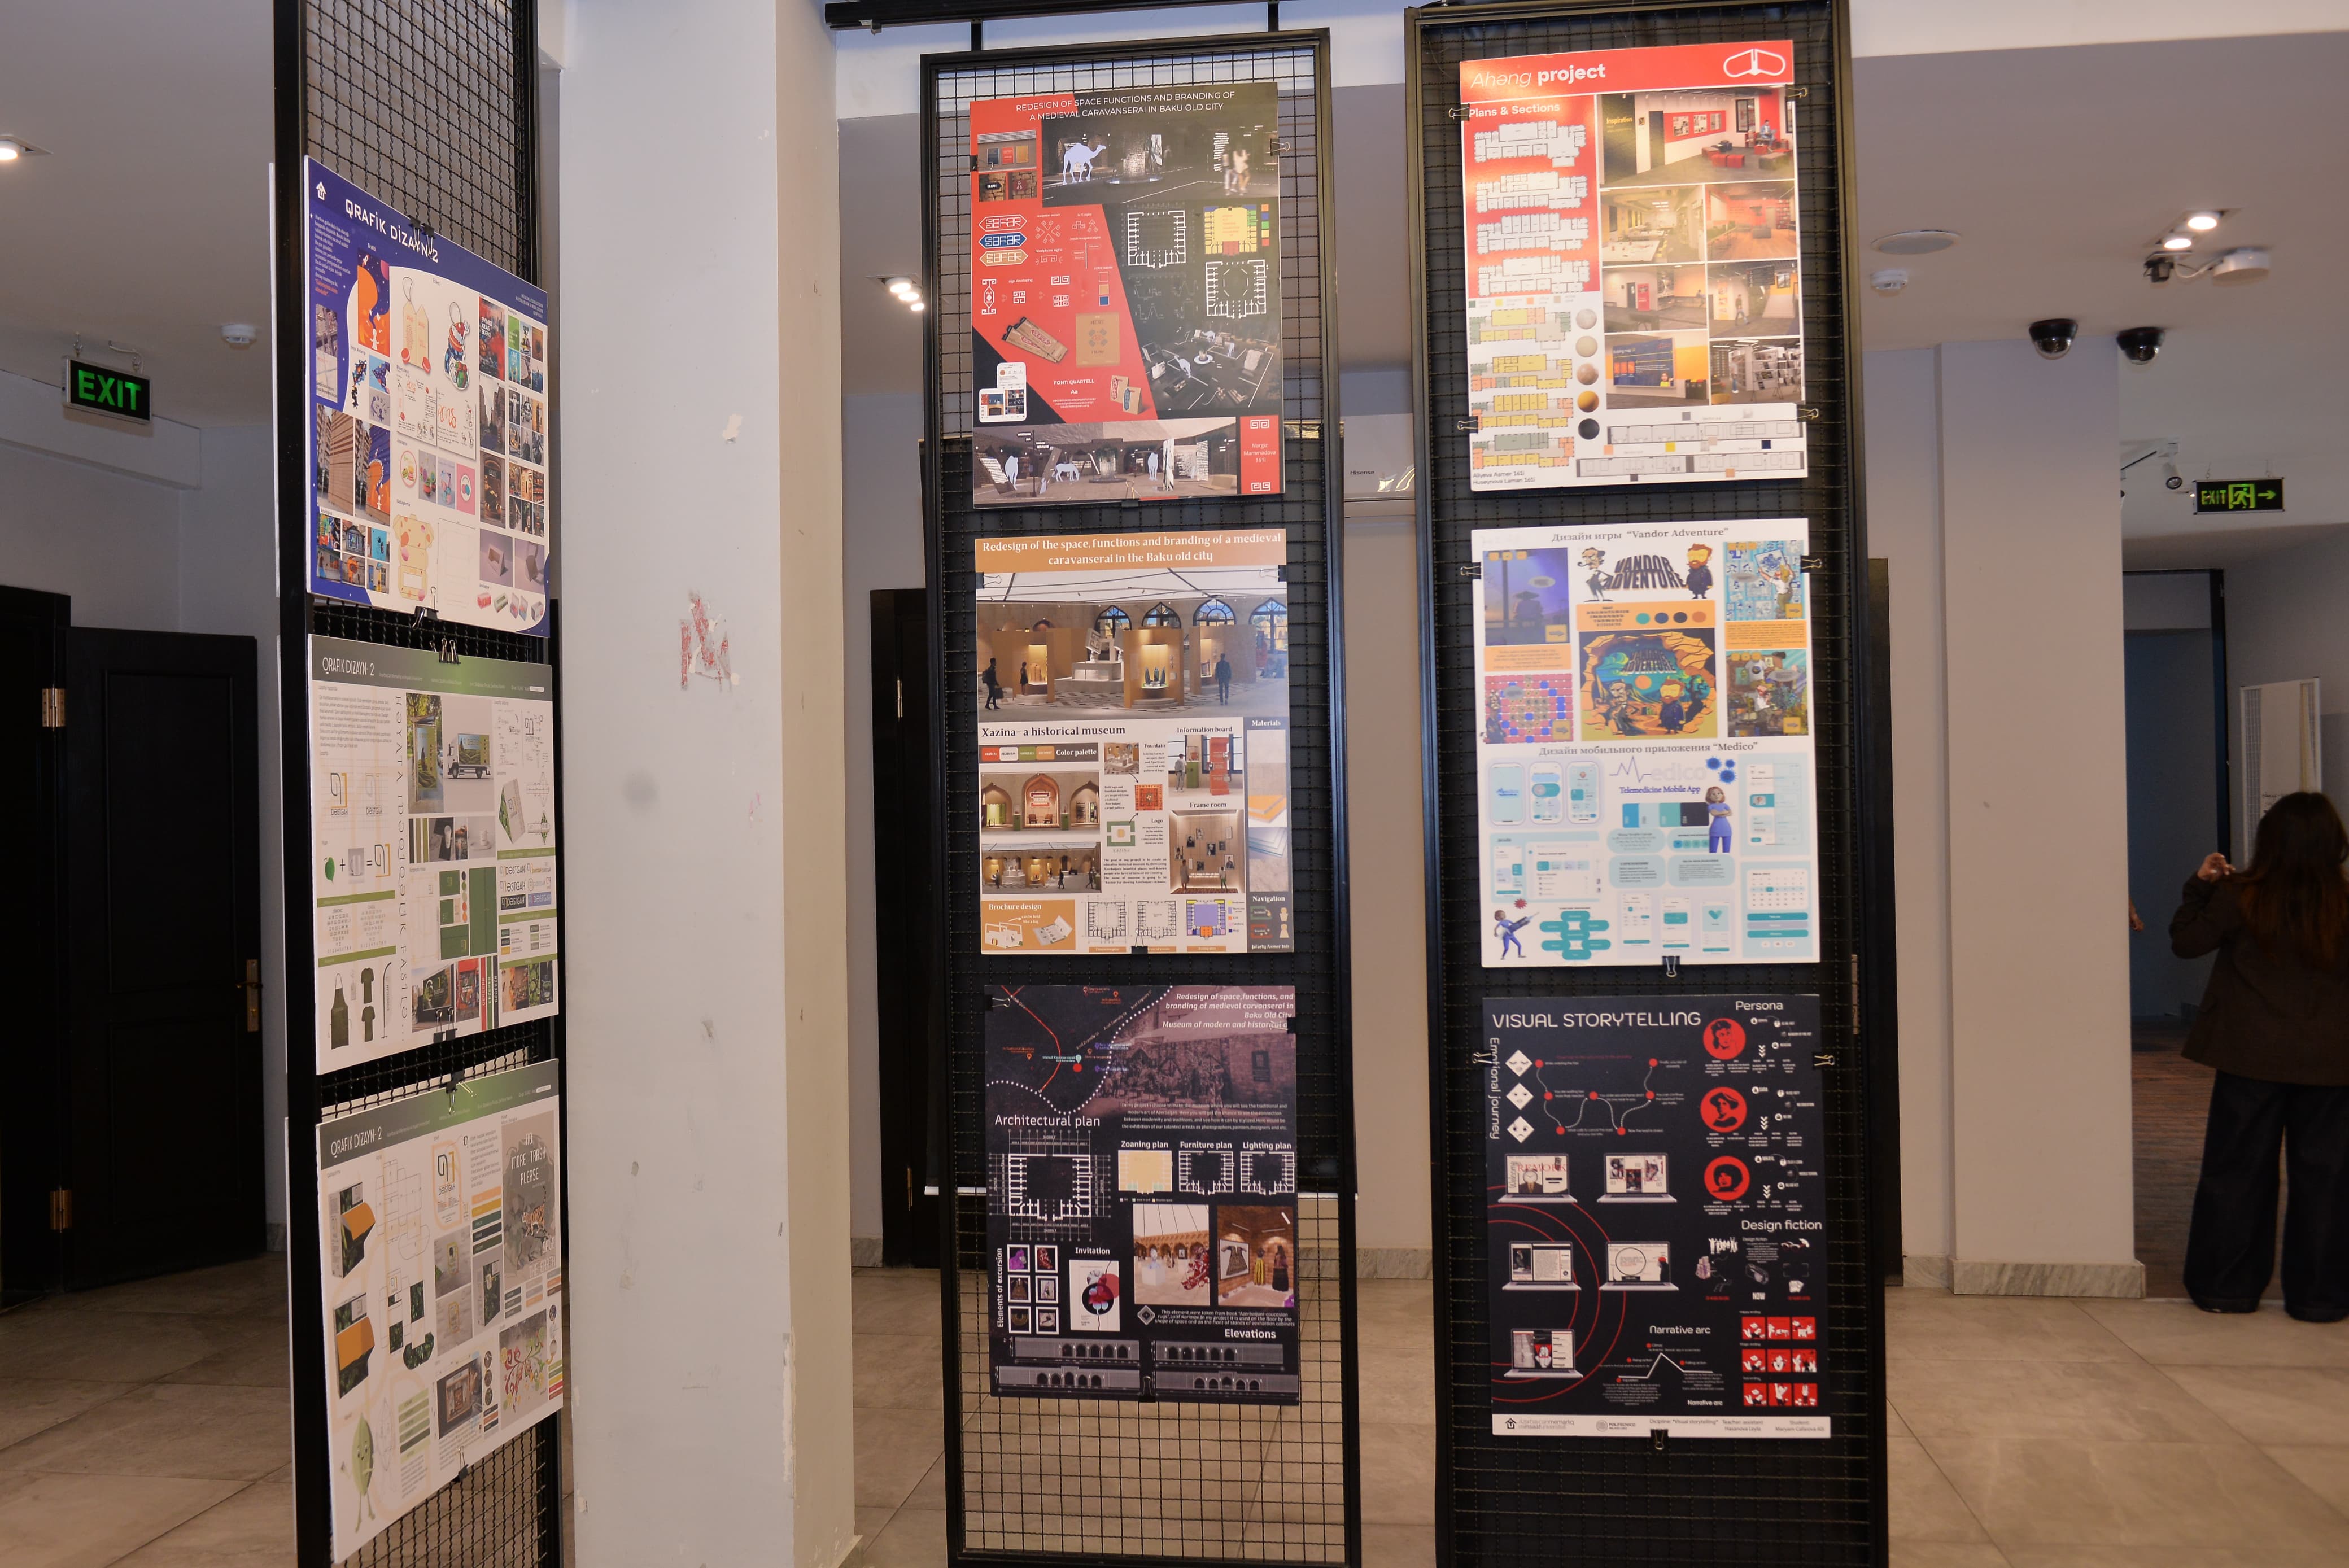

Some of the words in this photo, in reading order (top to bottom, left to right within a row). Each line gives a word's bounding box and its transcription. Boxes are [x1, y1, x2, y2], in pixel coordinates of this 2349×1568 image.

[1471, 72, 1531, 88] Ahəng
[1538, 64, 1606, 86] project
[1016, 101, 1059, 111] REDESIGN
[1075, 98, 1101, 107] SPACE
[1104, 95, 1152, 104] FUNCTIONS
[1175, 92, 1220, 101] BRANDING
[1038, 111, 1080, 120] MEDIEVAL
[1082, 107, 1146, 116] CARAVANSERAI
[1469, 107, 1497, 117] Plans
[1500, 107, 1508, 115] &
[1512, 103, 1560, 115] Sections
[345, 199, 387, 235] QRAFİK
[78, 370, 141, 411] EXIT
[2201, 490, 2226, 505] EXIT
[983, 541, 1028, 553] Redesign
[1030, 541, 1040, 549] of
[1042, 540, 1059, 549] the
[1060, 539, 1091, 551] space,
[1093, 538, 1140, 548] functions
[1143, 536, 1161, 546] and
[1164, 535, 1210, 547] branding
[1213, 535, 1222, 544] of
[1234, 533, 1281, 543] medieval
[1552, 531, 1592, 542] Дизайн
[1595, 532, 1622, 540] игры
[1049, 554, 1113, 565] caravanserai
[1116, 553, 1125, 562] in
[1128, 553, 1143, 562] the
[1147, 552, 1173, 562] Baku
[1175, 551, 1191, 560] old
[1193, 551, 1213, 562] city
[1614, 554, 1675, 574] VANDOR
[1603, 571, 1687, 590] ADVENTURE
[370, 663, 374, 676] 2
[1032, 726, 1079, 736] historical
[1539, 746, 1578, 756] Дизайн
[1580, 745, 1643, 754] мобильного
[1645, 744, 1711, 754] приложения
[1619, 786, 1662, 794] Telemedicine
[1687, 785, 1701, 795] App
[1735, 1001, 1784, 1010] Persona
[1492, 1014, 1558, 1028] VISUAL
[1563, 1012, 1701, 1027] STORYTELLING
[1489, 1037, 1500, 1087] Emotional
[1489, 1090, 1501, 1139] journey
[994, 1115, 1071, 1126] Architectural
[1075, 1115, 1101, 1129] plan
[378, 1126, 382, 1141] 2
[1121, 1141, 1150, 1149] Zoaning
[1152, 1141, 1168, 1150] plan
[1216, 1142, 1232, 1150] plan
[1243, 1141, 1274, 1151] Lighting
[1276, 1142, 1291, 1151] plan
[511, 1153, 526, 1169] MORE
[530, 1147, 546, 1163] TRASH
[520, 1168, 539, 1186] PLEASE
[1741, 1220, 1782, 1232] Design
[1785, 1220, 1822, 1230] fiction
[1225, 1329, 1277, 1339] Elevations
[1649, 1325, 1693, 1334] Narrative
